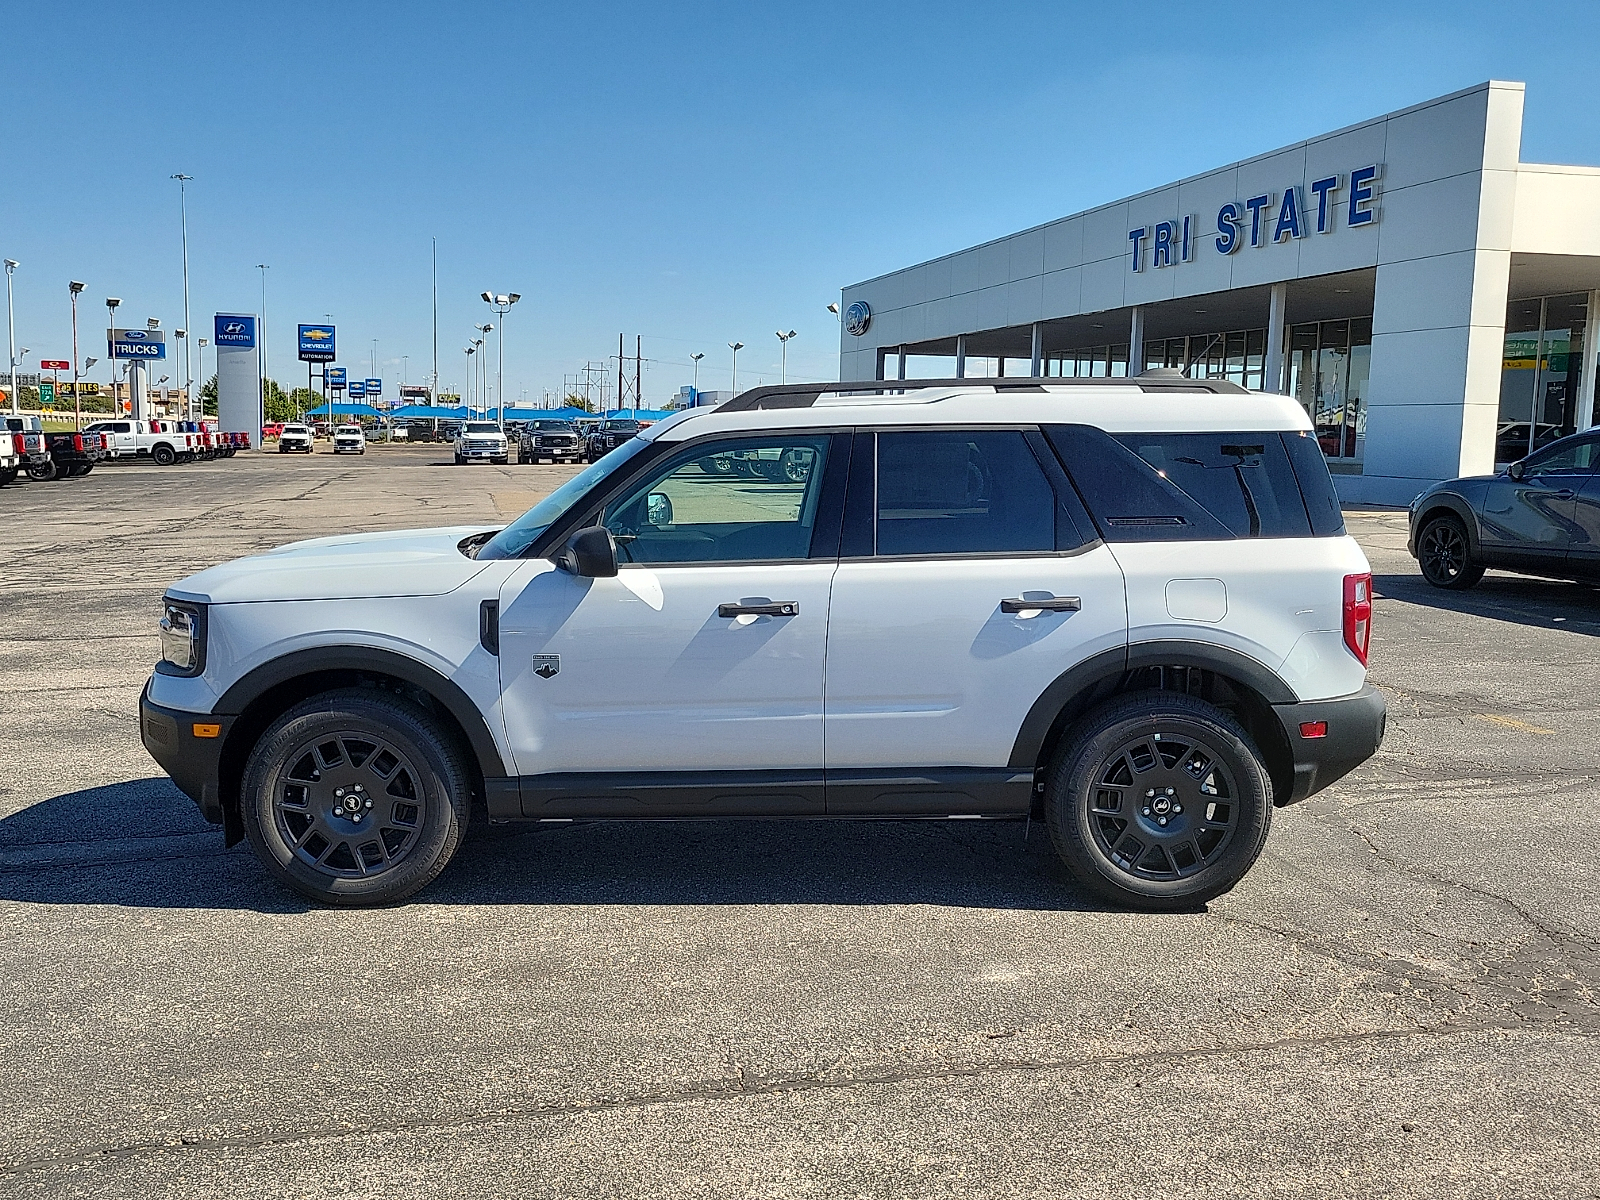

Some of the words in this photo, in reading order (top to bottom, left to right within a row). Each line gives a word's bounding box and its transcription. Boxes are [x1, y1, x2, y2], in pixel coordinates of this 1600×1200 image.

[1128, 213, 1195, 273] TRI
[1215, 163, 1382, 255] STATE
[115, 344, 159, 355] TRUCKS
